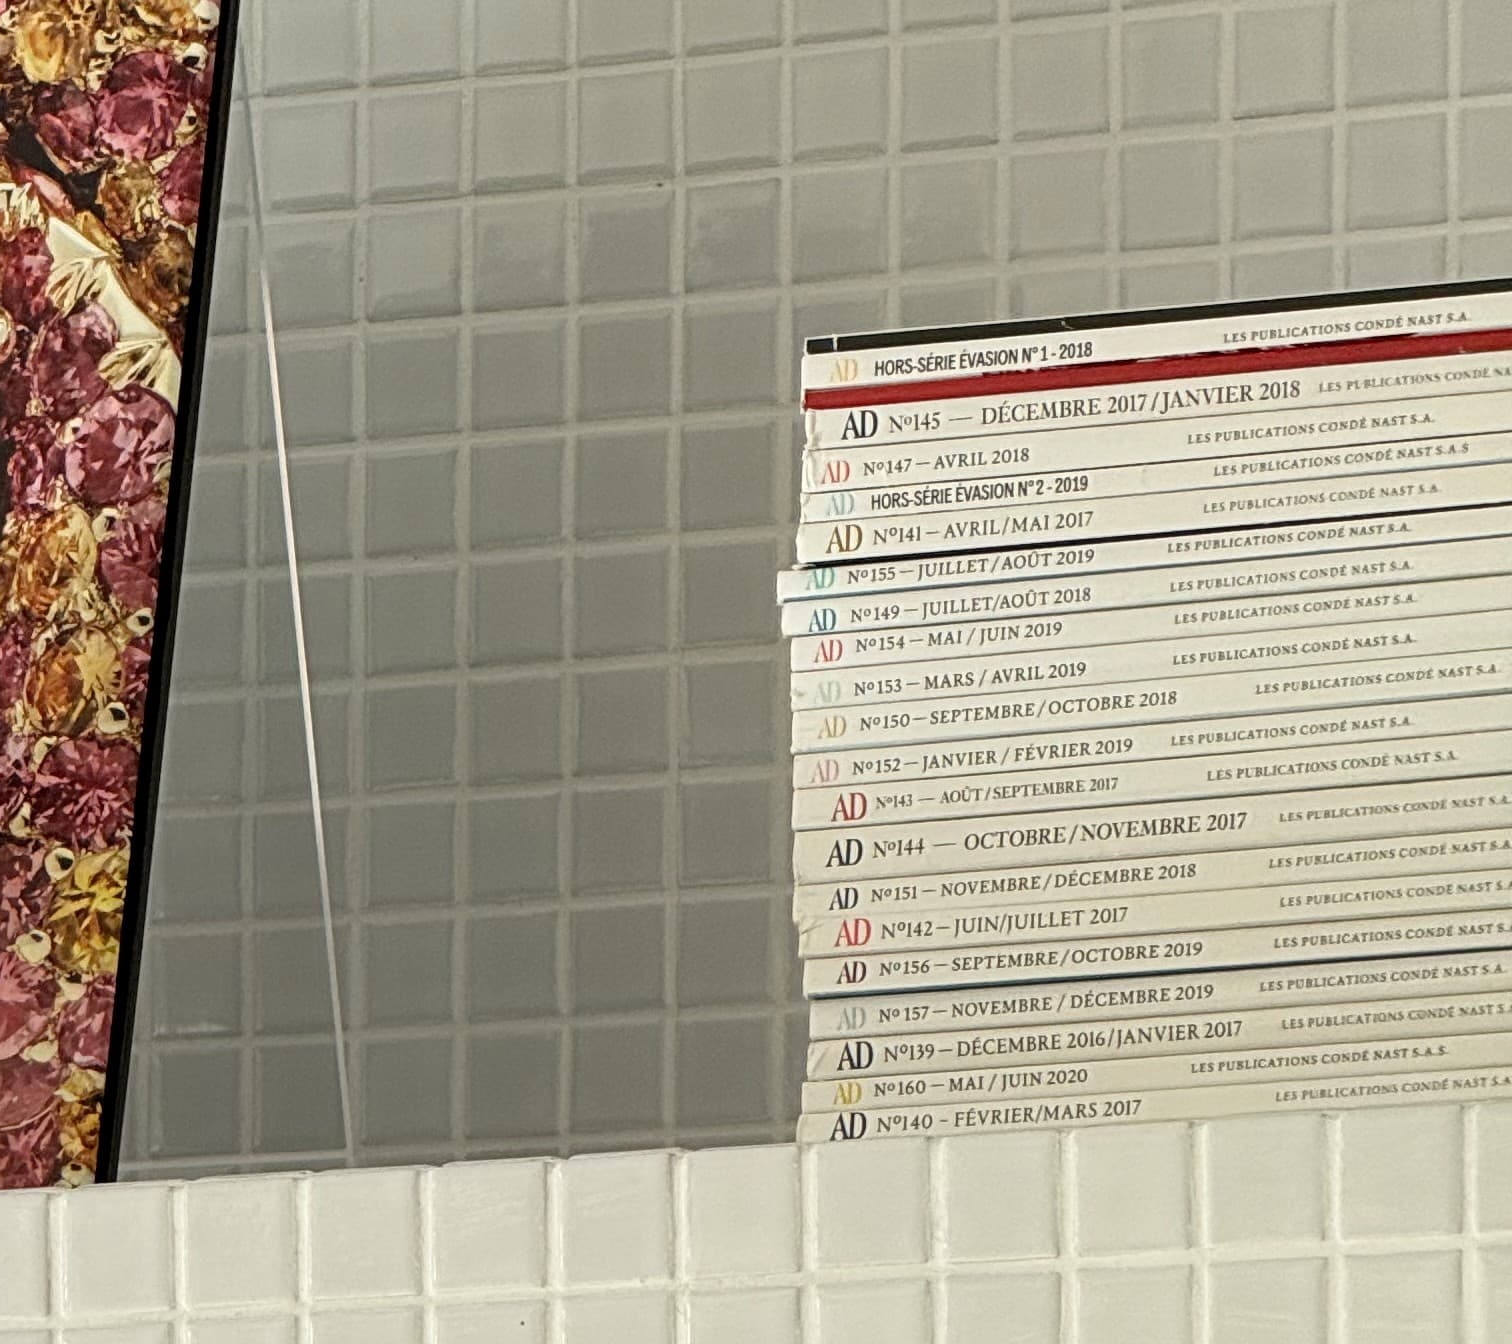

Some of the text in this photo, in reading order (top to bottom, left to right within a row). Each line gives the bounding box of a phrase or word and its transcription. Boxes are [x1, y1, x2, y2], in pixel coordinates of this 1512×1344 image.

[1223, 332, 1246, 343] LES
[1250, 322, 1350, 341] PUBLICATIONS
[1354, 315, 1402, 331] CONDÉ
[1407, 313, 1442, 326] NAST
[874, 352, 956, 376] HORS-SÉRIE
[960, 349, 1018, 368] ÉVASION
[1059, 341, 1092, 359] 2018
[841, 410, 878, 440] AD
[980, 398, 1101, 424] DÉCEMBRE
[1259, 380, 1300, 400] 2018
[1187, 432, 1210, 444] LES
[1215, 423, 1314, 442] PUBLICATIONS
[1318, 417, 1366, 432] CONDÉ
[1371, 415, 1407, 428] NAST
[821, 460, 850, 484] AD
[934, 451, 987, 469] AVRIL
[992, 447, 1029, 464] 2018
[871, 485, 952, 510] HORS-SÉRIE
[956, 481, 1014, 502] ÉVASION
[1055, 475, 1088, 493] 2019
[826, 524, 862, 553] AD
[1055, 511, 1093, 529] 2017
[1056, 549, 1094, 565] 2019
[809, 608, 836, 632] AD
[1054, 587, 1090, 604] 2018
[814, 639, 843, 663] AD
[928, 630, 962, 646] MAI
[980, 625, 1019, 645] JUIN
[1024, 621, 1062, 638] 2019
[1172, 653, 1196, 665] LES
[1200, 644, 1298, 662] PUBLICATIONS
[1300, 638, 1349, 653] CONDÉ
[1353, 636, 1388, 648] NAST
[924, 672, 974, 690] MARS
[991, 666, 1044, 684] AVRIL
[1048, 662, 1086, 678] 2019
[818, 715, 846, 738] AD
[1139, 691, 1176, 707] 2018
[810, 759, 839, 783] AD
[923, 750, 996, 773] JANVIER
[1014, 742, 1091, 762] FÉVRIER
[1095, 738, 1132, 754] 2019
[831, 792, 867, 821] AD
[1089, 777, 1118, 792] 2017
[825, 838, 862, 867] AD
[1206, 812, 1247, 831] 2017
[829, 887, 858, 910] AD
[1158, 863, 1196, 879] 2018
[834, 918, 871, 947] AD
[1089, 906, 1128, 924] 2017
[836, 961, 866, 984] AD
[1163, 941, 1202, 957] 2019
[1259, 980, 1282, 992] LES
[1287, 972, 1386, 990] PUBLICATIONS
[1390, 967, 1438, 981] CONDÉ
[1443, 965, 1478, 977] NAST
[952, 997, 1052, 1017] NOVEMBRE
[1070, 988, 1170, 1008] DÉCEMBRE
[1174, 984, 1213, 1000] 2019
[837, 1041, 873, 1071] AD
[957, 1034, 1061, 1057] DÉCEMBRE
[1204, 1020, 1242, 1038] 2017
[833, 1082, 862, 1104] AD
[948, 1076, 984, 1092] MAI
[1002, 1072, 1041, 1092] JUIN
[1046, 1068, 1088, 1085] 2020
[830, 1112, 866, 1141] AD
[1102, 1099, 1142, 1116] 2017
